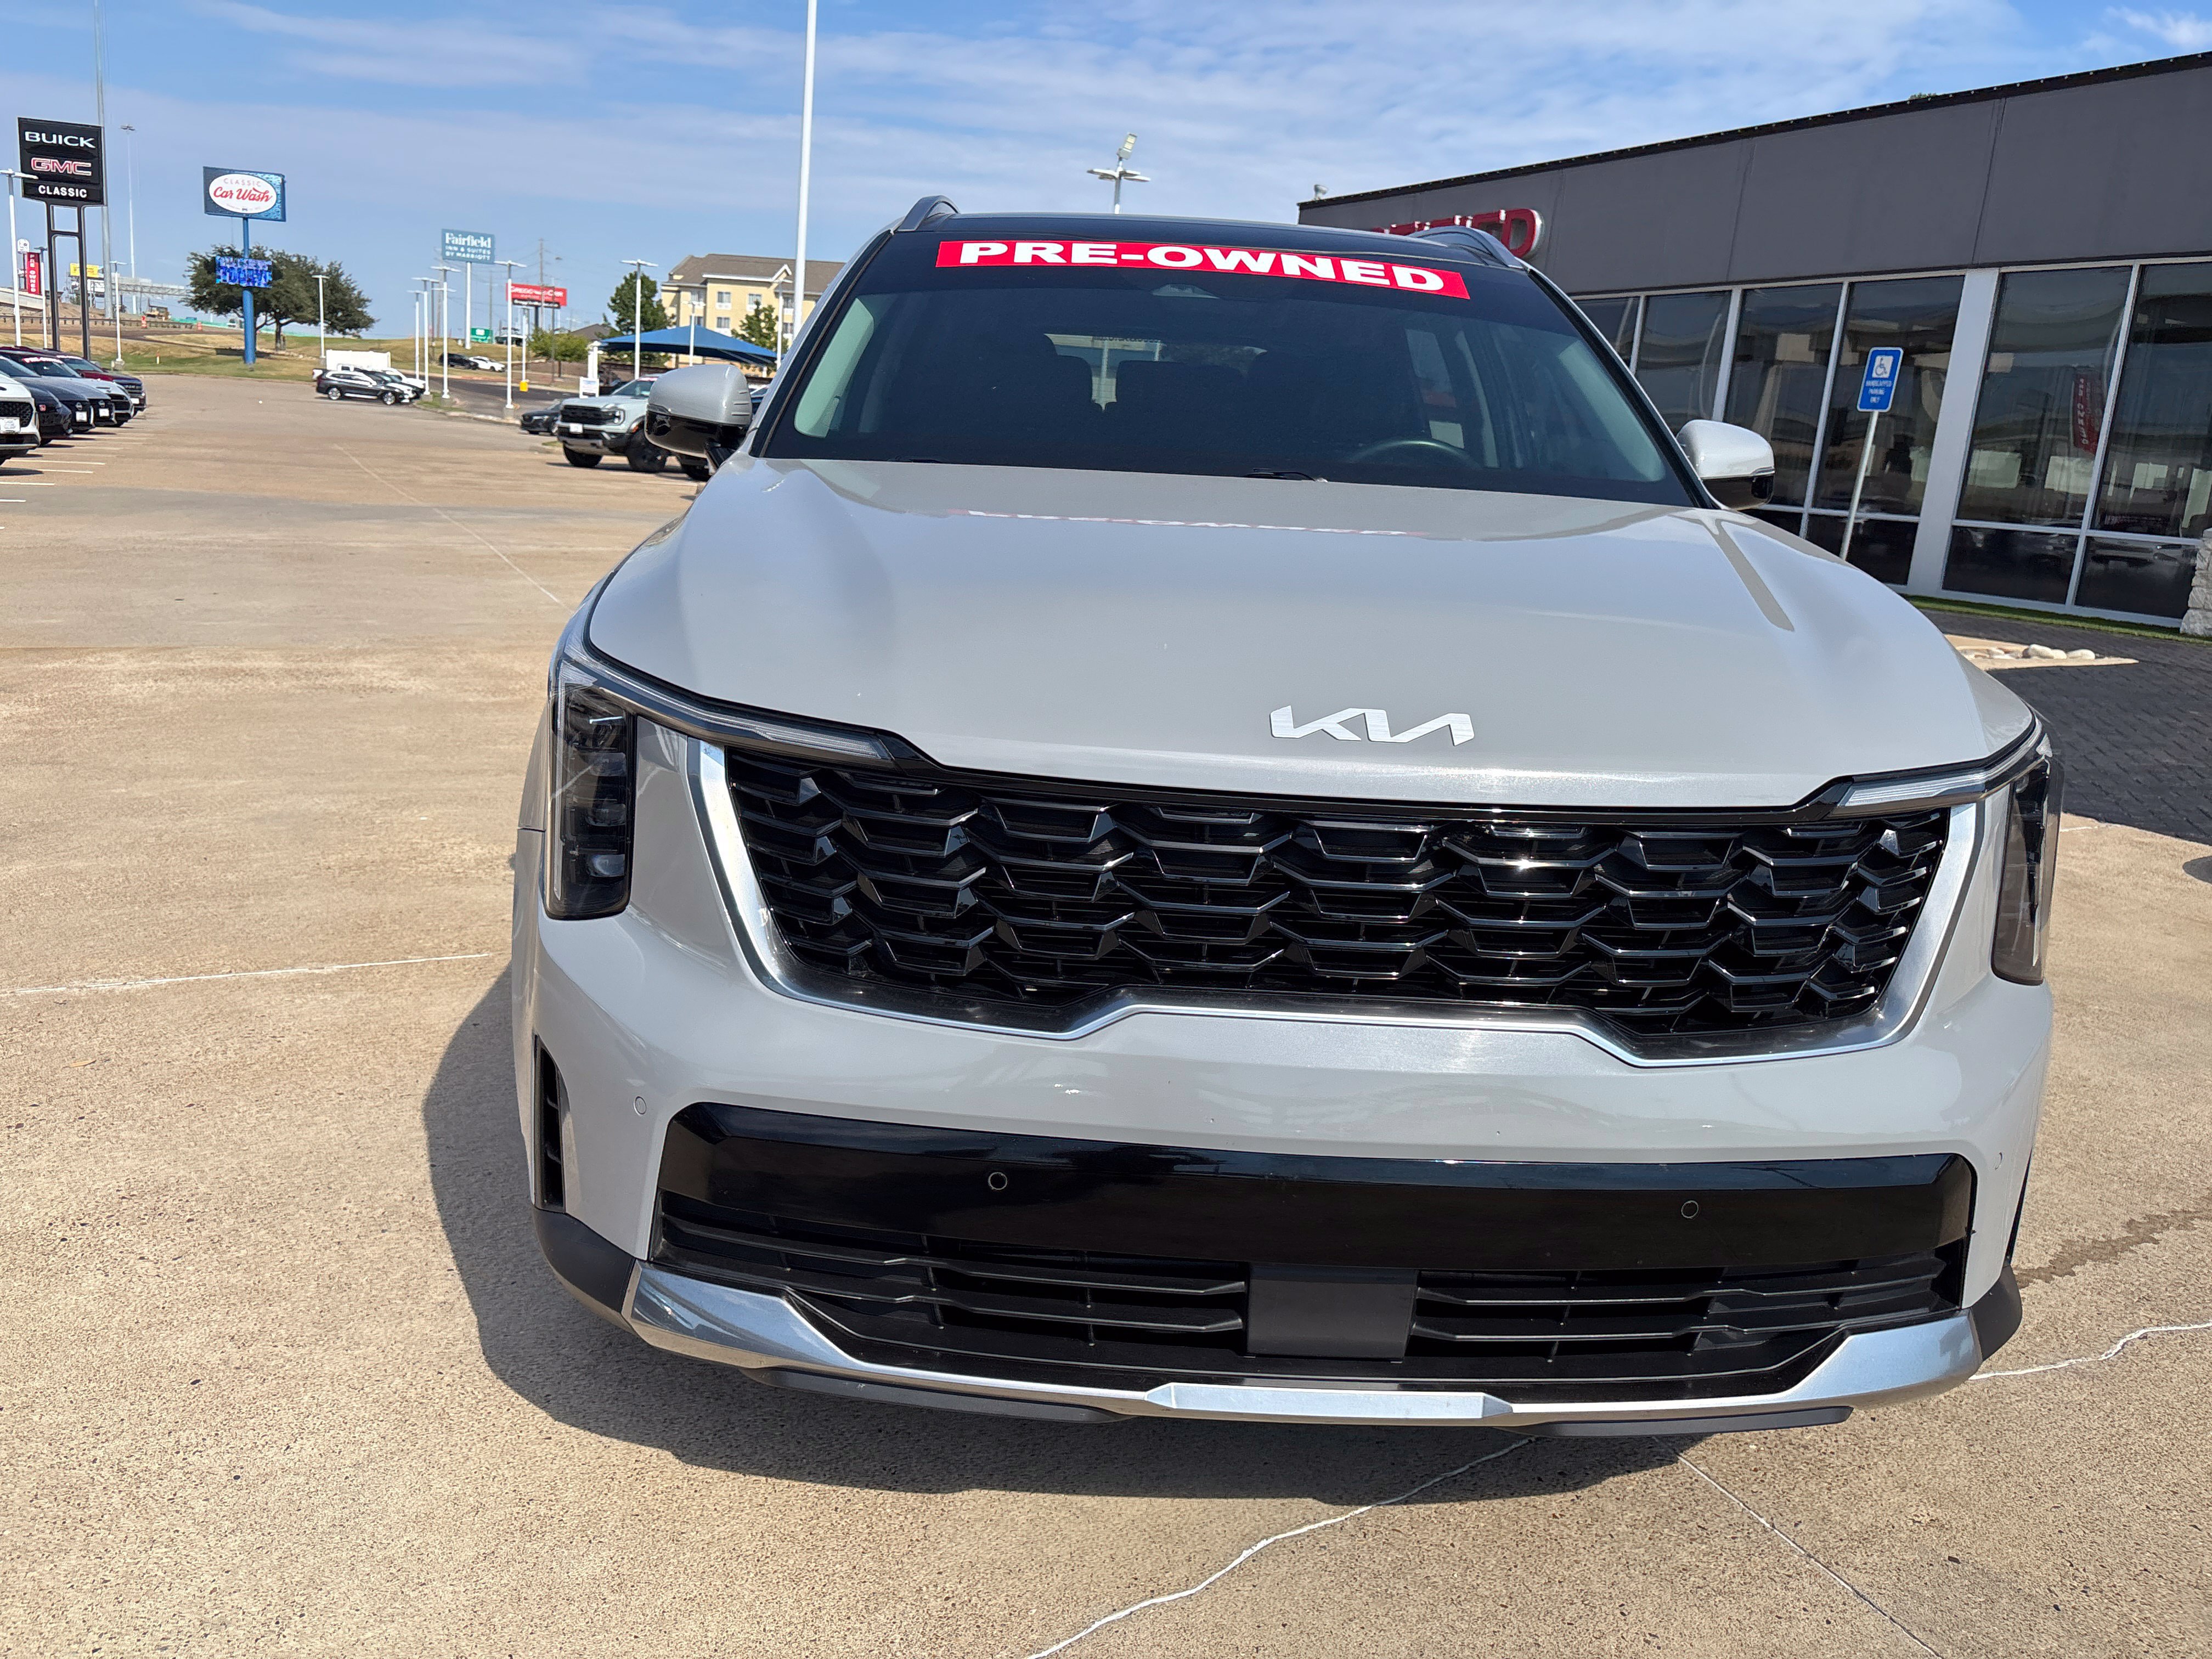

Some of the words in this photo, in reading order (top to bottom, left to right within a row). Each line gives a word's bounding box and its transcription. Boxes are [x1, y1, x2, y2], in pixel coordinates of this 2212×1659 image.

[25, 131, 96, 149] BUICK
[31, 157, 92, 176] GMC
[223, 178, 262, 187] CLASSIC
[38, 185, 87, 198] CLASSIC
[213, 187, 234, 199] Car
[236, 187, 273, 202] Wash
[445, 232, 492, 248] Fairfield
[456, 252, 490, 261] MARRIOTT
[959, 241, 1444, 291] PRE-OWNED
